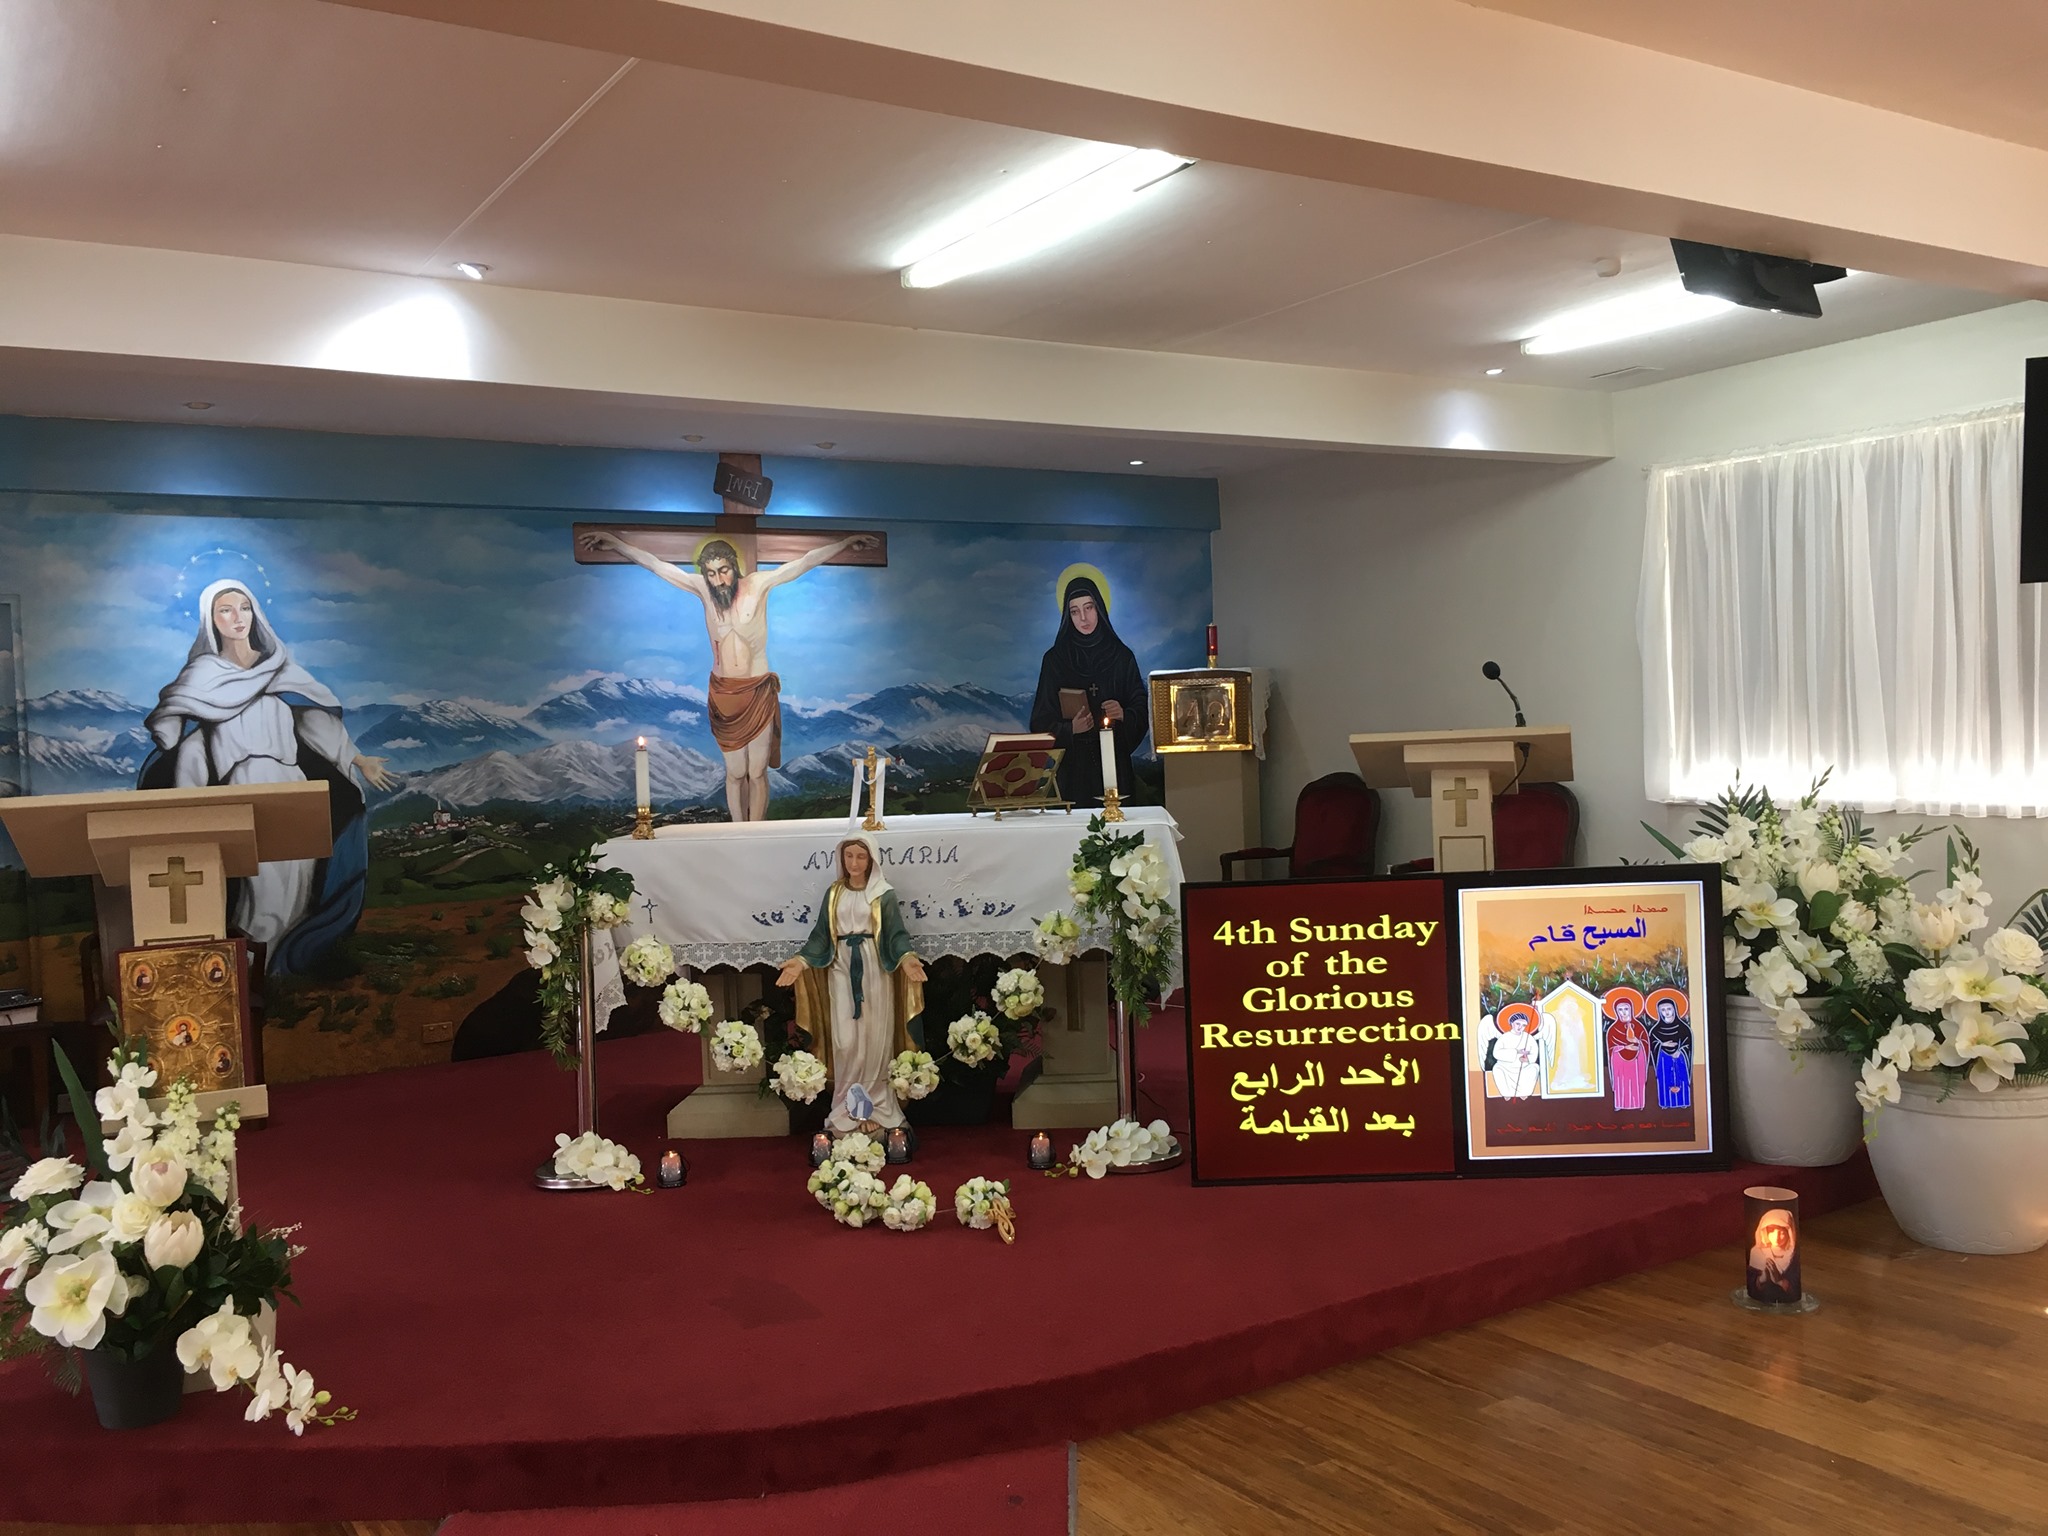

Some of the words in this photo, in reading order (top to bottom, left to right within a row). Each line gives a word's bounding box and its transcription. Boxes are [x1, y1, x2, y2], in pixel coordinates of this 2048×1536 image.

[725, 473, 763, 501] INRI
[803, 850, 836, 871] AV
[1213, 919, 1277, 946] 4th
[1289, 914, 1439, 947] Sunday
[1528, 924, 1576, 951] قام
[1583, 917, 1646, 949] المسيح
[1266, 951, 1310, 978] of
[1325, 949, 1388, 976] the
[1242, 984, 1415, 1013] Glorious
[1199, 1016, 1462, 1049] Resurrection
[1230, 1059, 1325, 1102] الرابع
[1340, 1053, 1420, 1086] الأحد
[1239, 1104, 1349, 1142] القيامة
[1364, 1111, 1416, 1138] بعد
